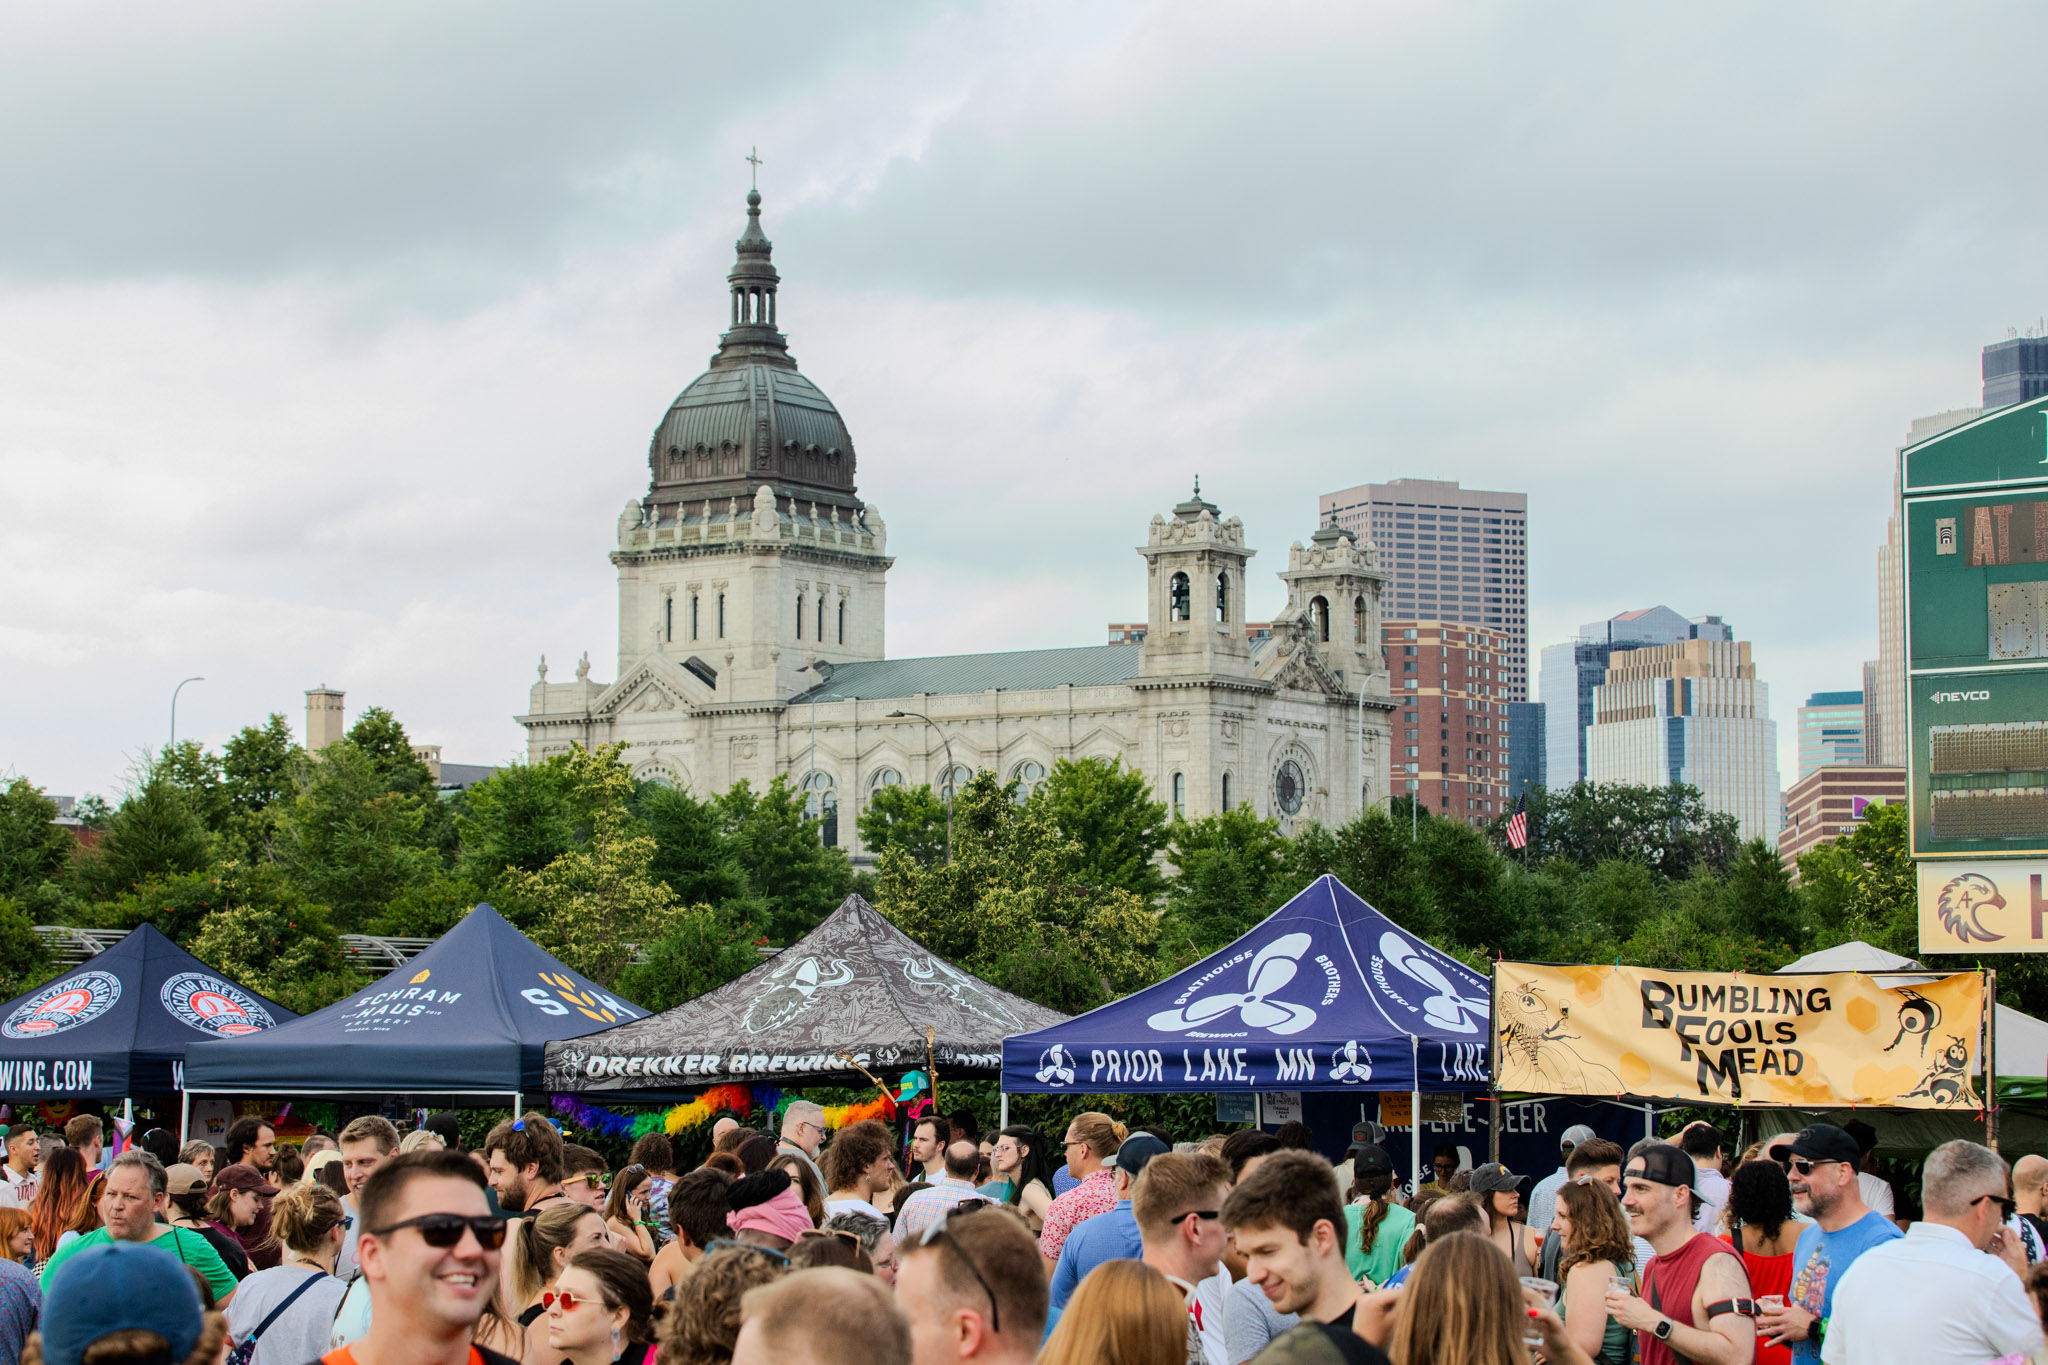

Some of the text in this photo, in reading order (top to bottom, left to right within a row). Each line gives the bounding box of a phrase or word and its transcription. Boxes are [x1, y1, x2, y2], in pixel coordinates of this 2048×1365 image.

[1973, 505, 2013, 566] AT
[355, 987, 462, 1008] SCHRAM
[1174, 949, 1341, 1006] BOATHOUSE BROTHERS
[1371, 954, 1420, 1013] BOATHOUSE
[18, 978, 91, 1018] WACONIA
[75, 979, 111, 1020] BREWING
[172, 980, 201, 1023] WACONIA
[198, 980, 263, 1022] BREWING
[355, 1003, 426, 1019] HAUS
[520, 988, 570, 1016] S
[1640, 979, 1832, 1029] BUMBLING
[207, 1015, 256, 1028] COMPANY
[344, 1018, 411, 1028] BREWERY
[1184, 1030, 1249, 1038] BREWING
[1675, 1015, 1797, 1062] FOOLS
[586, 1053, 872, 1077] DREKKER BREWING
[1091, 1048, 1316, 1086] PRIOR LAKE, MN
[1695, 1047, 1804, 1098] MEAD
